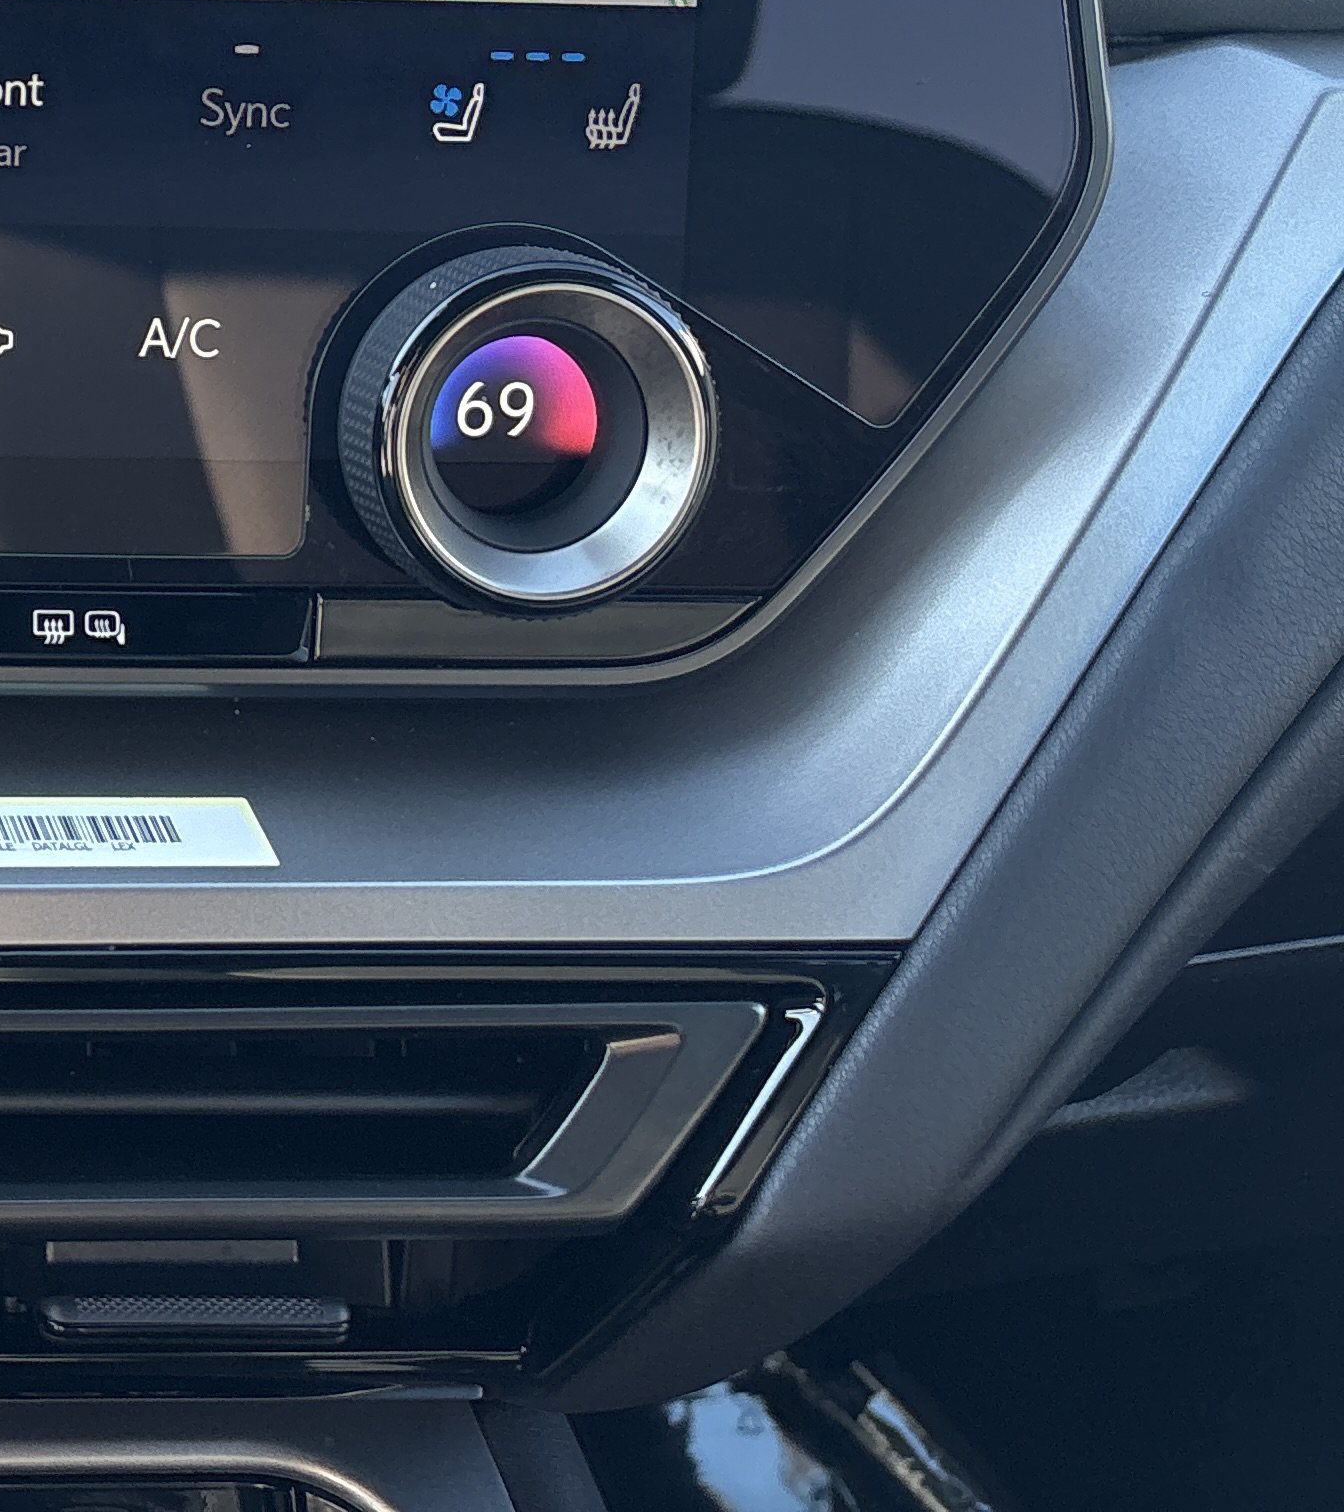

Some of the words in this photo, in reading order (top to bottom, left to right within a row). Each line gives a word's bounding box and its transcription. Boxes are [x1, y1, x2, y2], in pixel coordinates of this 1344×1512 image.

[200, 87, 292, 136] Sync
[139, 317, 222, 359] A/C
[456, 380, 536, 439] 69
